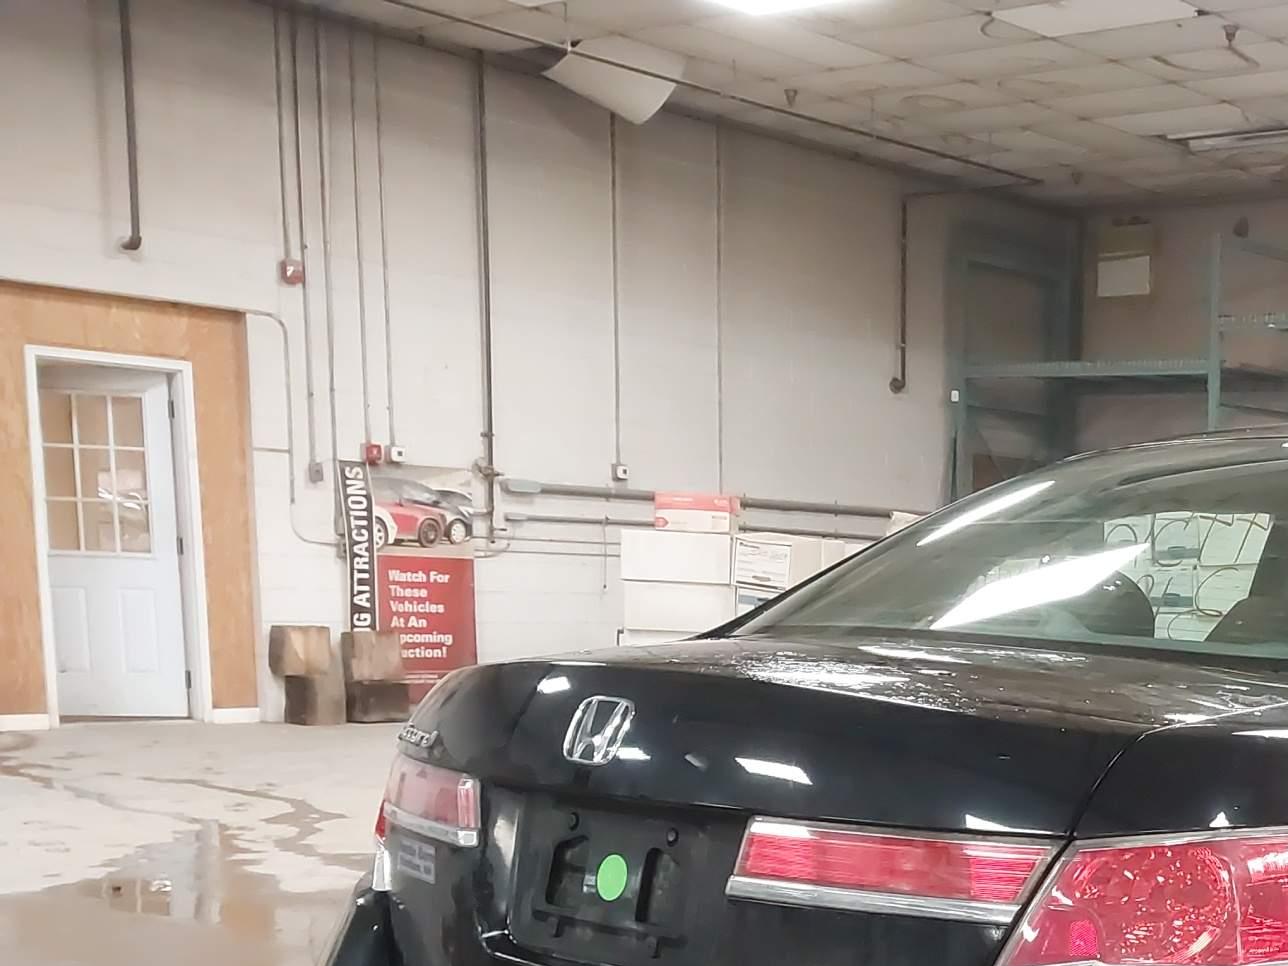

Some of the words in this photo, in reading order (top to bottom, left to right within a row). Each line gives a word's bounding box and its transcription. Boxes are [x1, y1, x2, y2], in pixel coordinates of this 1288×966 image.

[344, 466, 371, 608] ATTRACTIONS
[388, 570, 426, 583] Watch
[429, 571, 450, 583] For
[389, 585, 428, 597] These
[390, 601, 445, 613] Vehicles
[391, 616, 405, 627] At
[408, 616, 427, 627] An
[400, 632, 453, 645] pcoming
